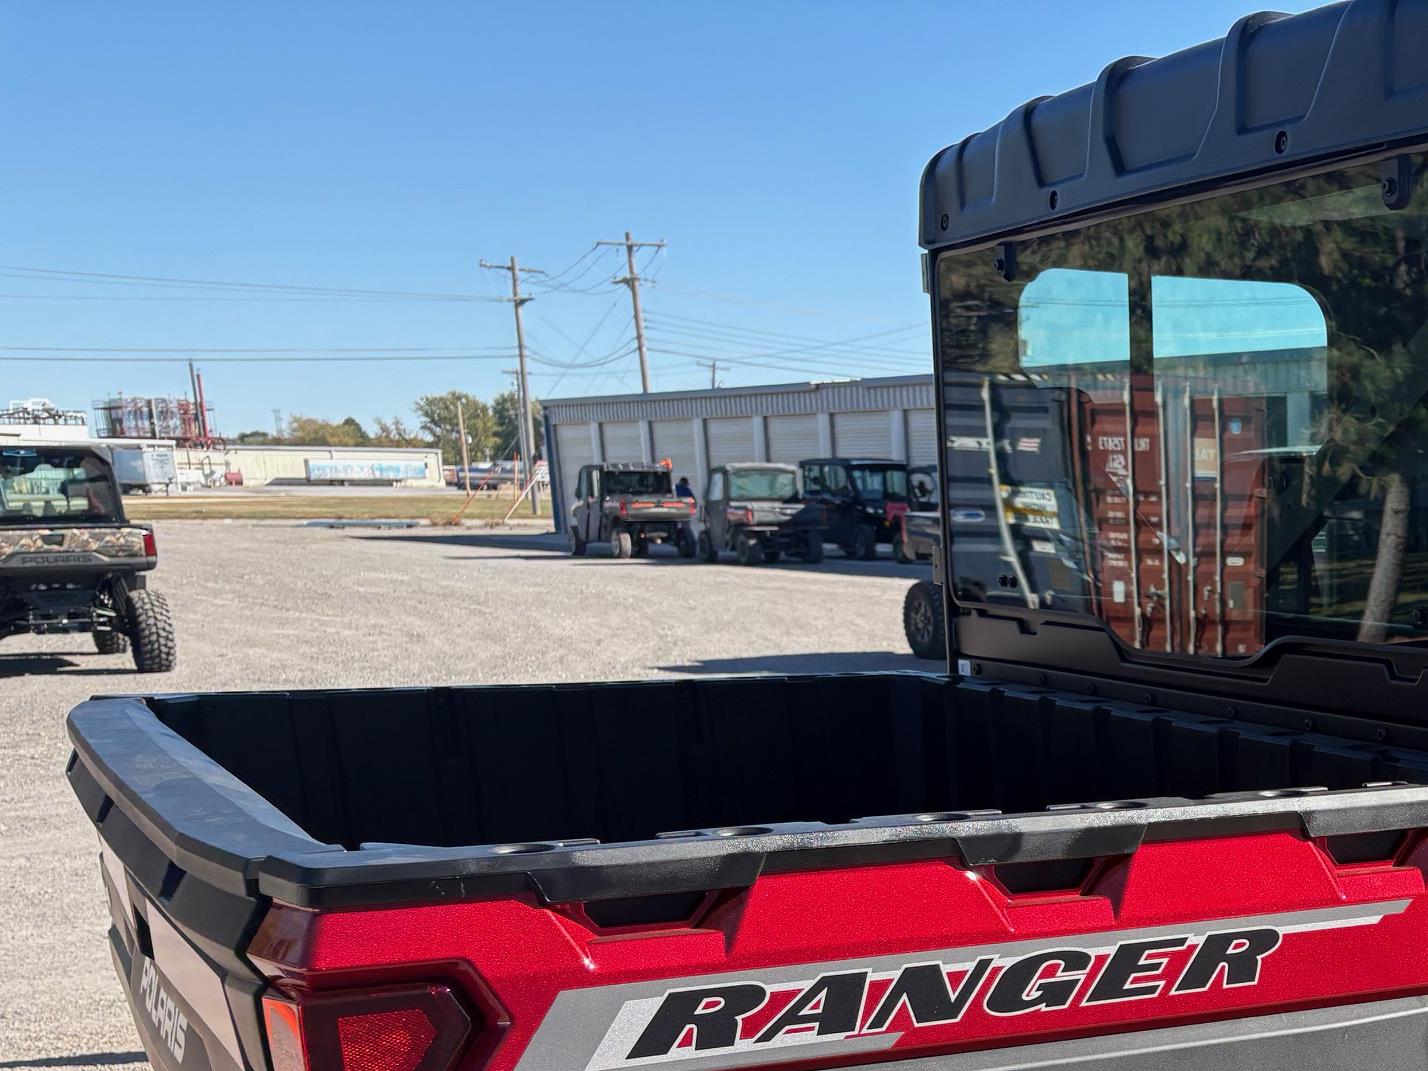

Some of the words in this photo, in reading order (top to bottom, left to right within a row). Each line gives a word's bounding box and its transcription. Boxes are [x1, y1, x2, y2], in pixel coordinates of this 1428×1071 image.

[21, 554, 93, 565] POLARIS
[141, 958, 189, 1065] POLARIS
[624, 926, 1284, 1061] RANGER
